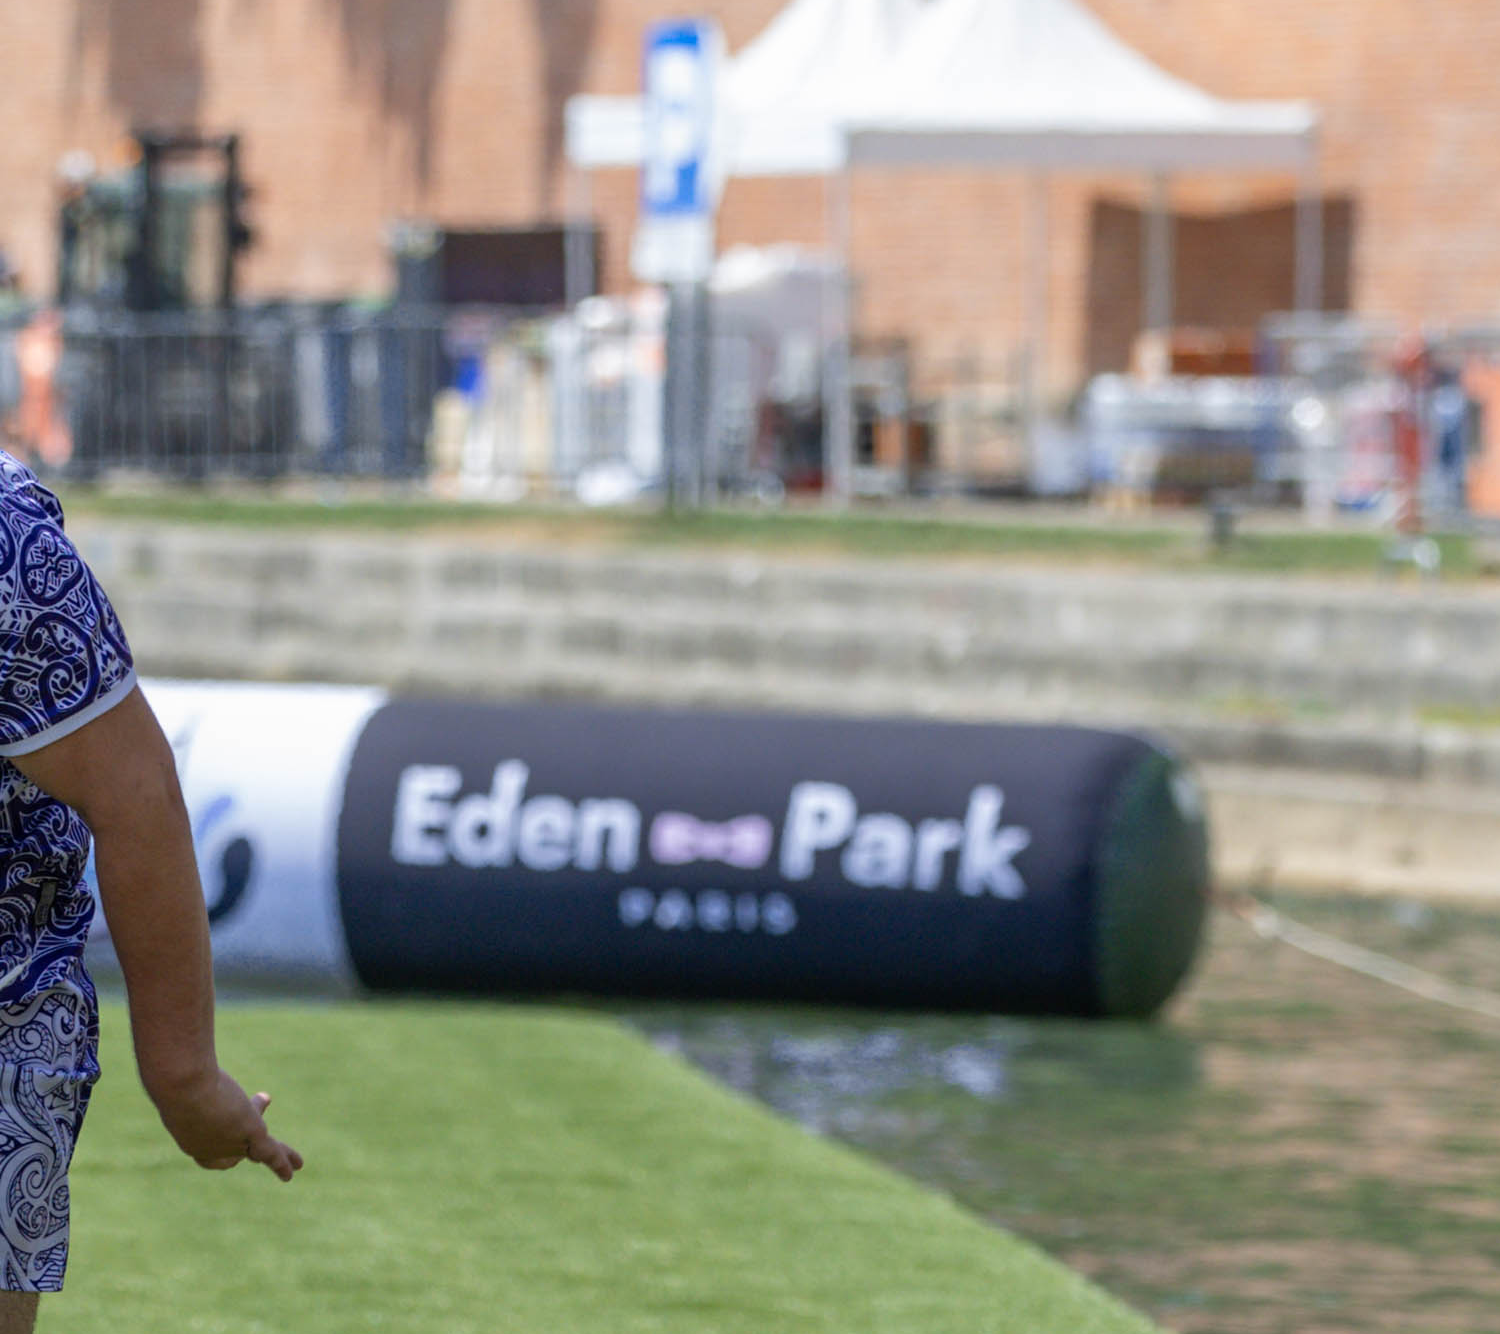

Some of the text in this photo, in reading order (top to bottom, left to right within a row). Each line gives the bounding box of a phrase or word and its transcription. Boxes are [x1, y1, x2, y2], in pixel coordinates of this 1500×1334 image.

[389, 758, 1032, 902] Eden Park
[615, 885, 799, 936] PARIS
